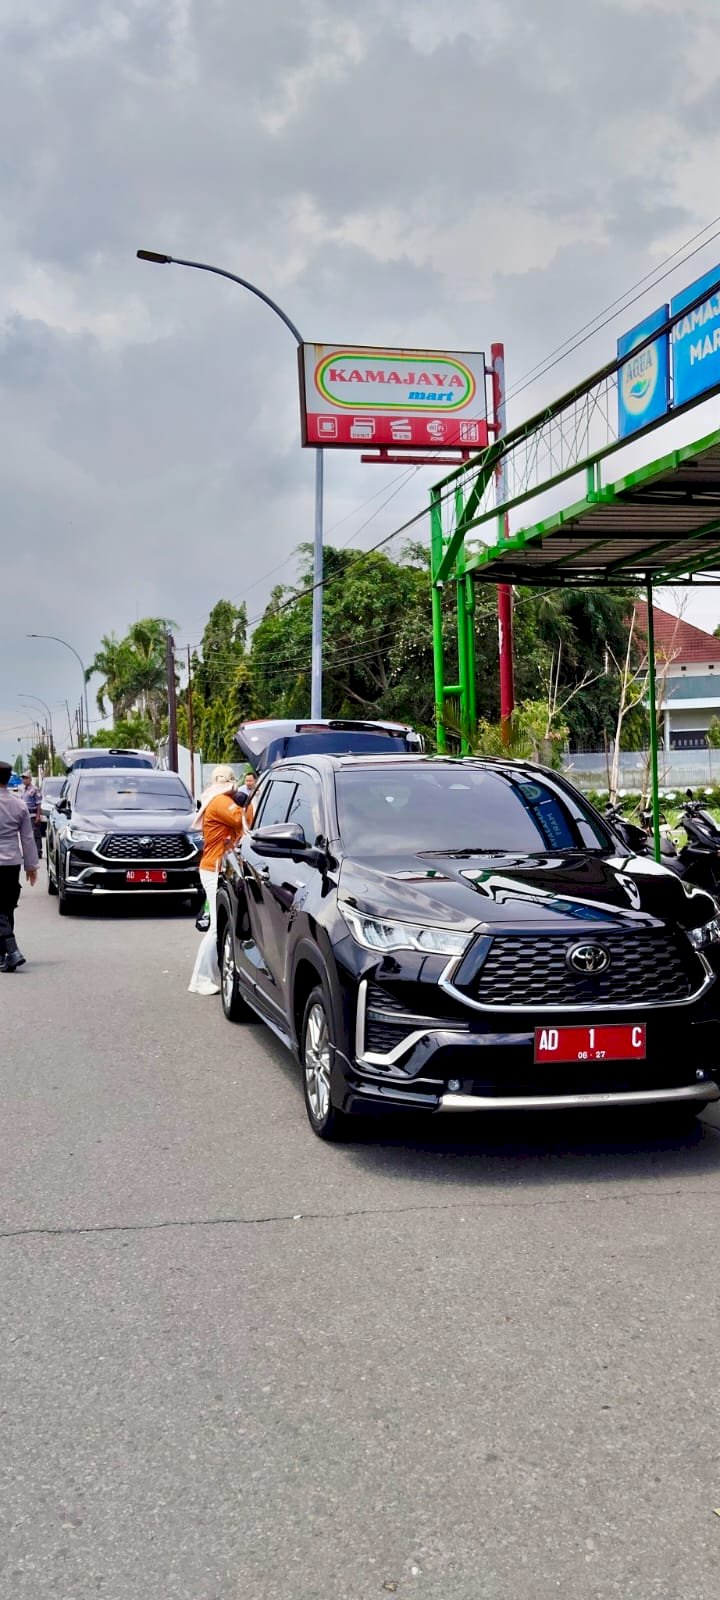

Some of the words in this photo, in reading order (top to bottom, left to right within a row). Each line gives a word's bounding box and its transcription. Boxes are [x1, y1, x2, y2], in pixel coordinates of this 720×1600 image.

[625, 349, 653, 383] AQUA
[329, 368, 465, 388] KAMAJAYA
[408, 391, 455, 402] mart
[539, 1029, 559, 1051] AD
[588, 1028, 595, 1049] 1
[631, 1026, 642, 1048] C
[577, 1051, 588, 1059] 06
[595, 1050, 606, 1058] 27
